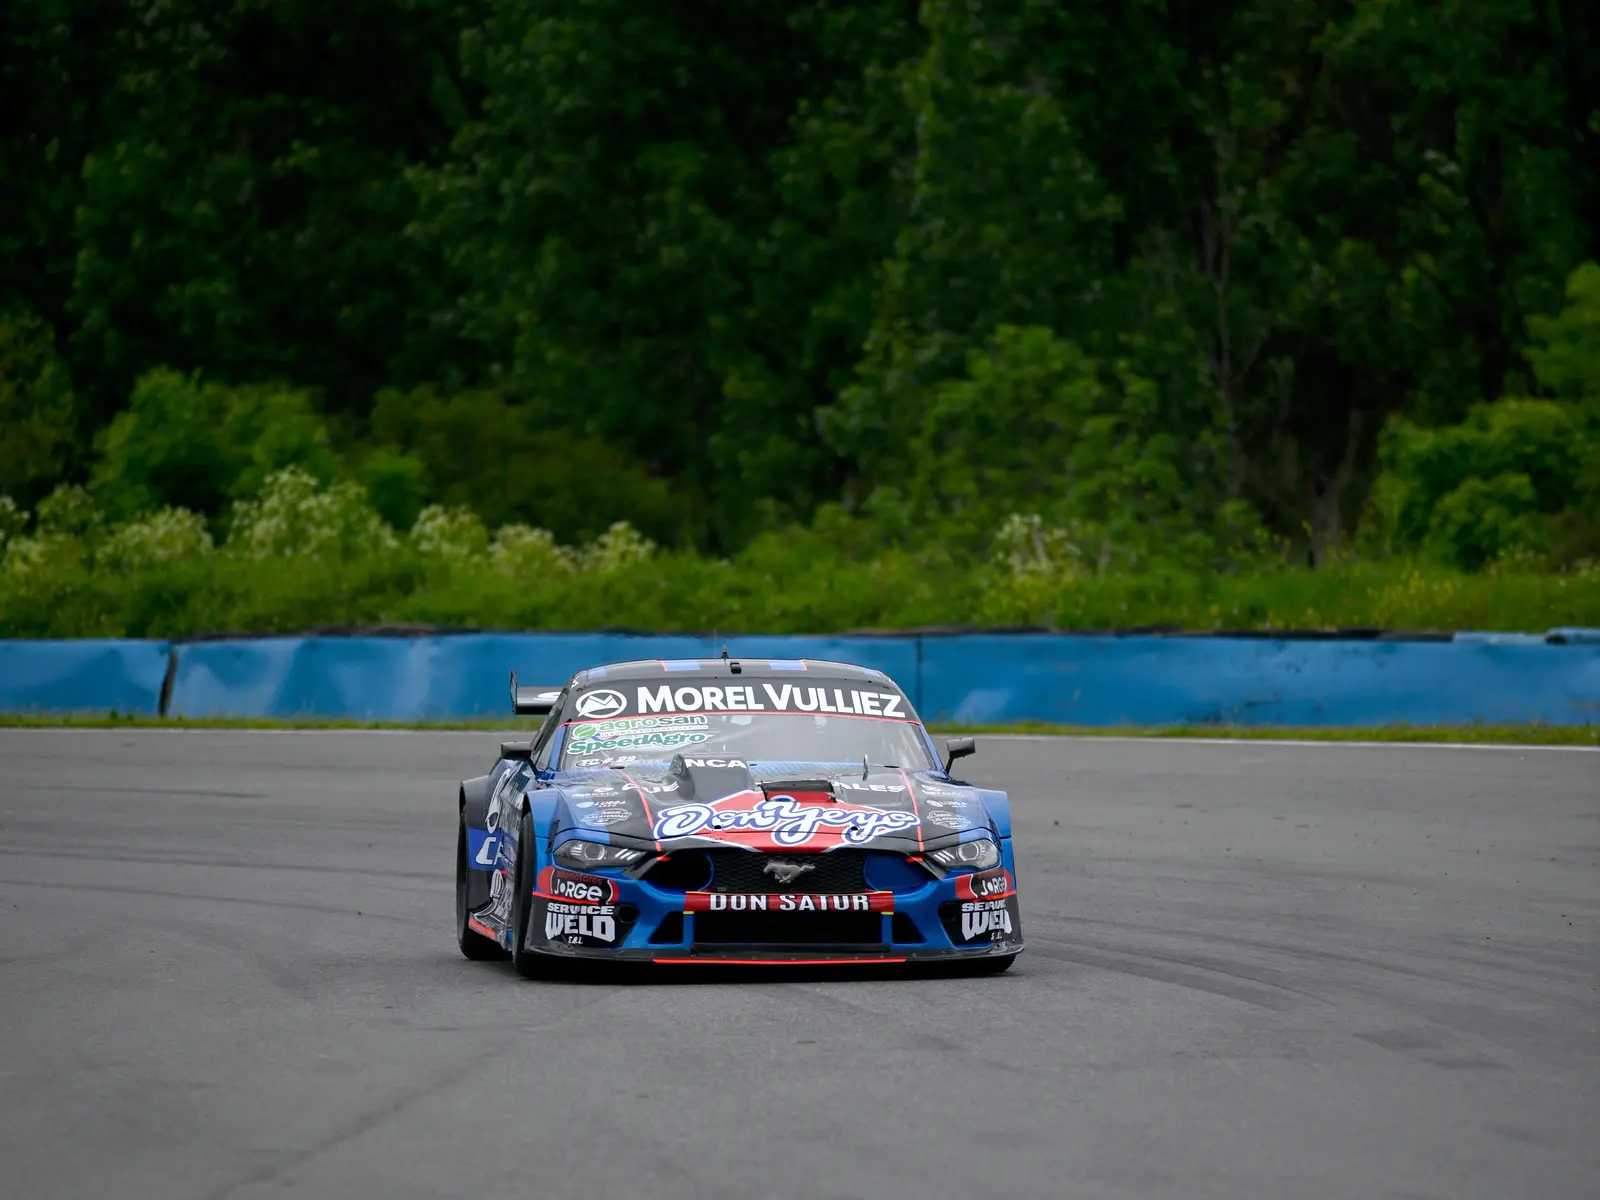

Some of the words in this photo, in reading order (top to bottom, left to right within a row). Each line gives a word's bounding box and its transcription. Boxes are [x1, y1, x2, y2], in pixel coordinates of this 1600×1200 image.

[637, 685, 764, 714] MOREL
[762, 683, 906, 718] VULLIEZ
[599, 715, 707, 732] agrosan
[568, 732, 706, 754] SpeedAgro
[547, 902, 615, 915] SERVICE
[709, 894, 768, 911] DON
[778, 894, 870, 911] SATUR
[545, 911, 616, 943] WELD
